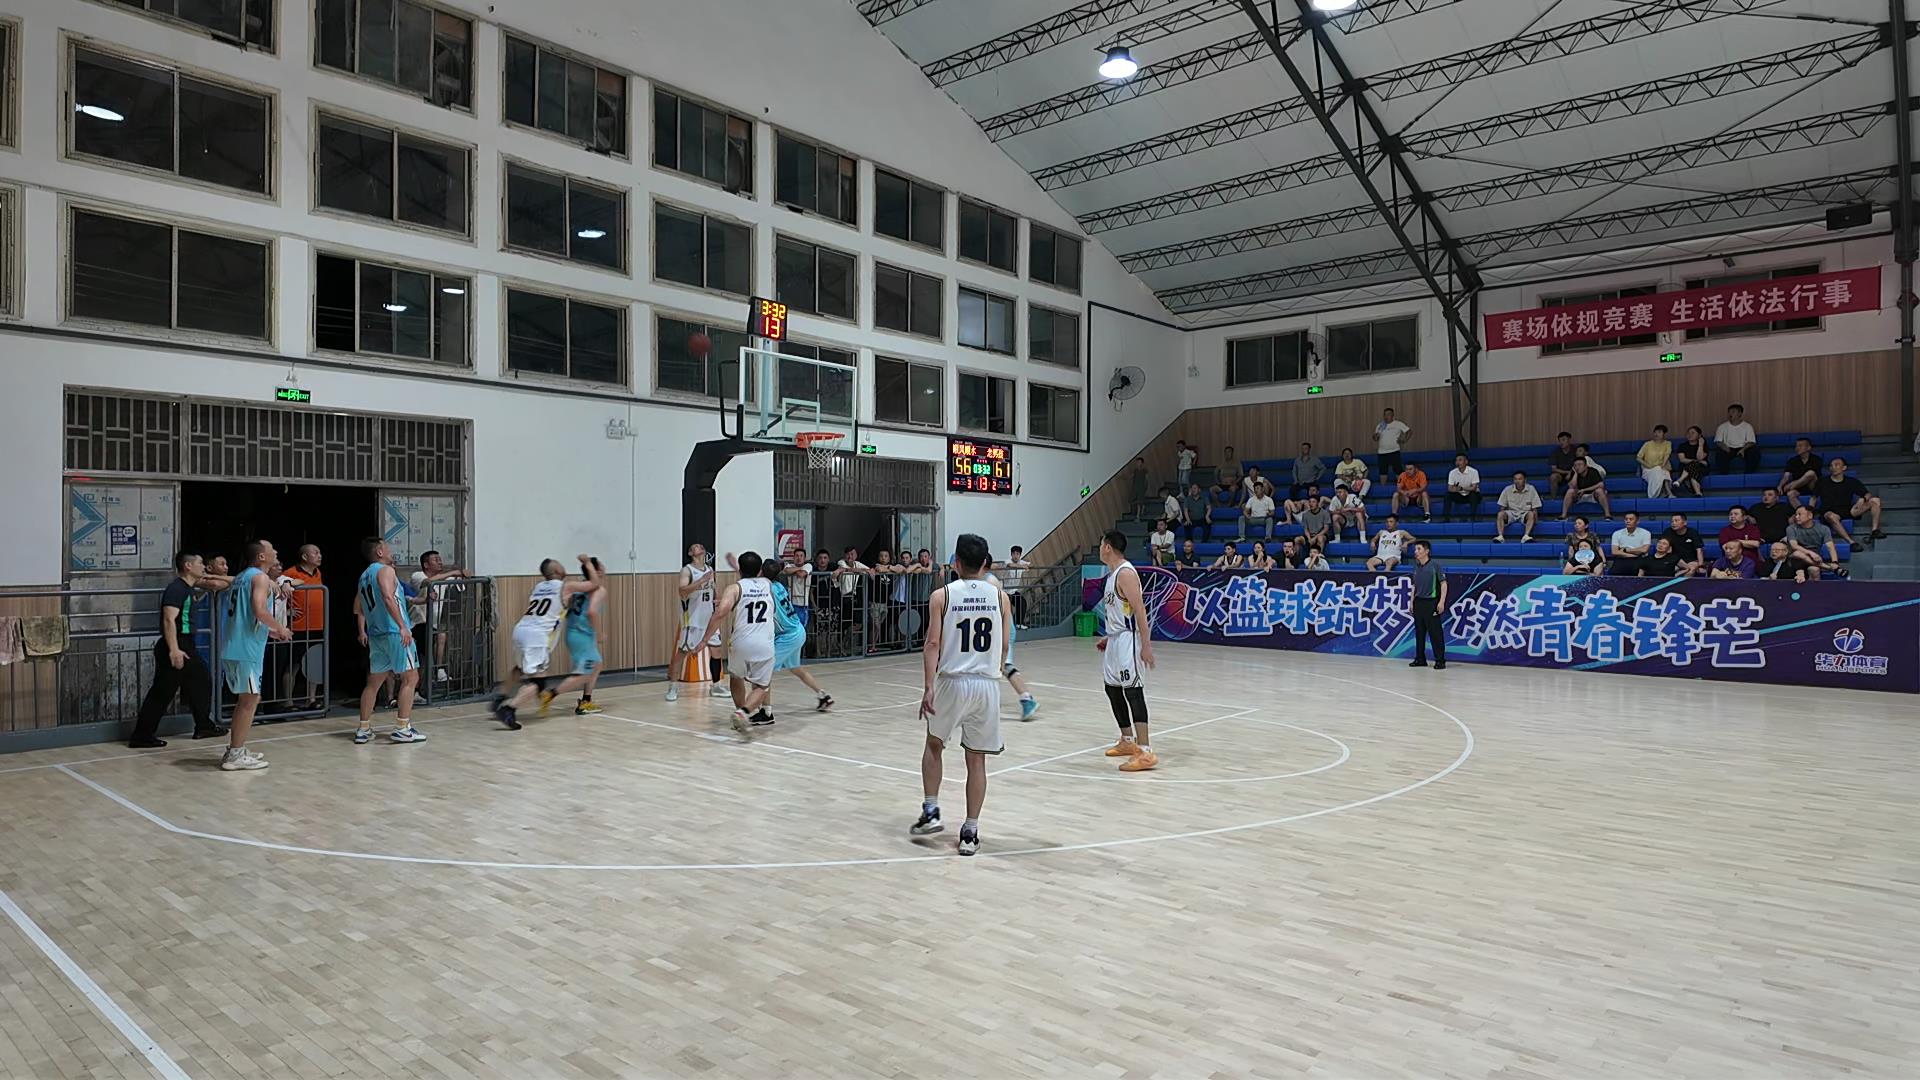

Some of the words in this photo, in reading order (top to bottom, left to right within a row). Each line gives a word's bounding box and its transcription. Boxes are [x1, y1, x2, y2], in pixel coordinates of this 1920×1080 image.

[762, 300, 786, 319] 3:32
[1502, 303, 1653, 343] 赛场依规竞赛
[1670, 279, 1853, 325] 生活依法行事
[765, 316, 780, 338] 13
[955, 458, 971, 475] 56
[973, 463, 991, 475] 03:32
[995, 461, 1010, 478] 61
[967, 479, 972, 489] 3
[979, 477, 988, 490] 13
[992, 481, 997, 491] 2
[524, 597, 552, 617] 20
[702, 592, 710, 602] 15
[745, 600, 768, 624] 12
[1184, 575, 1414, 656] 以篮球筑梦
[1450, 585, 1766, 668] 燃青春锋芒
[956, 617, 993, 653] 18
[1815, 653, 1888, 668] 华力体育
